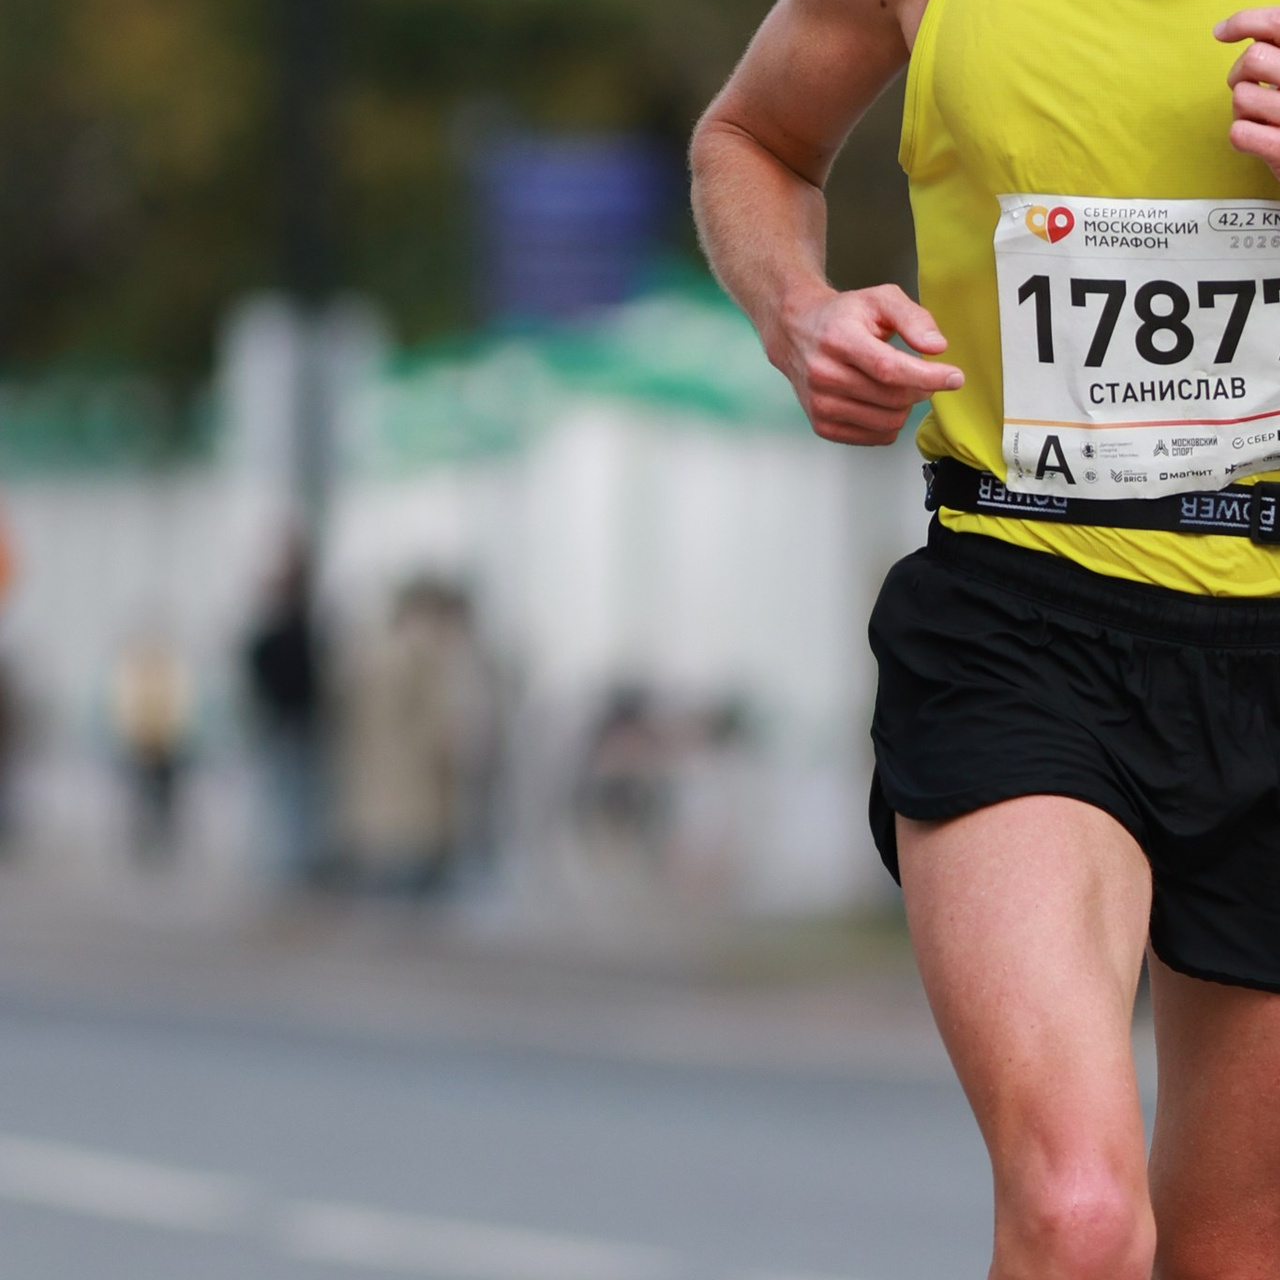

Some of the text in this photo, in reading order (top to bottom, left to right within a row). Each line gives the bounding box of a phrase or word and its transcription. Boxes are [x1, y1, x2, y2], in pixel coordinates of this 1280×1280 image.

[1083, 207, 1168, 219] СБЕРПРАЙМ
[1218, 212, 1255, 227] 42,2
[1084, 220, 1199, 235] МОСКОВСКИЙ
[1085, 235, 1169, 249] МАРАФОН
[1089, 375, 1247, 406] СТАНИСЛАВ
[1171, 436, 1218, 447] МОСКОВСКИЙ
[1246, 432, 1276, 445] СБЕР
[1172, 447, 1194, 457] СПОРТ
[1123, 475, 1148, 483] BRICS
